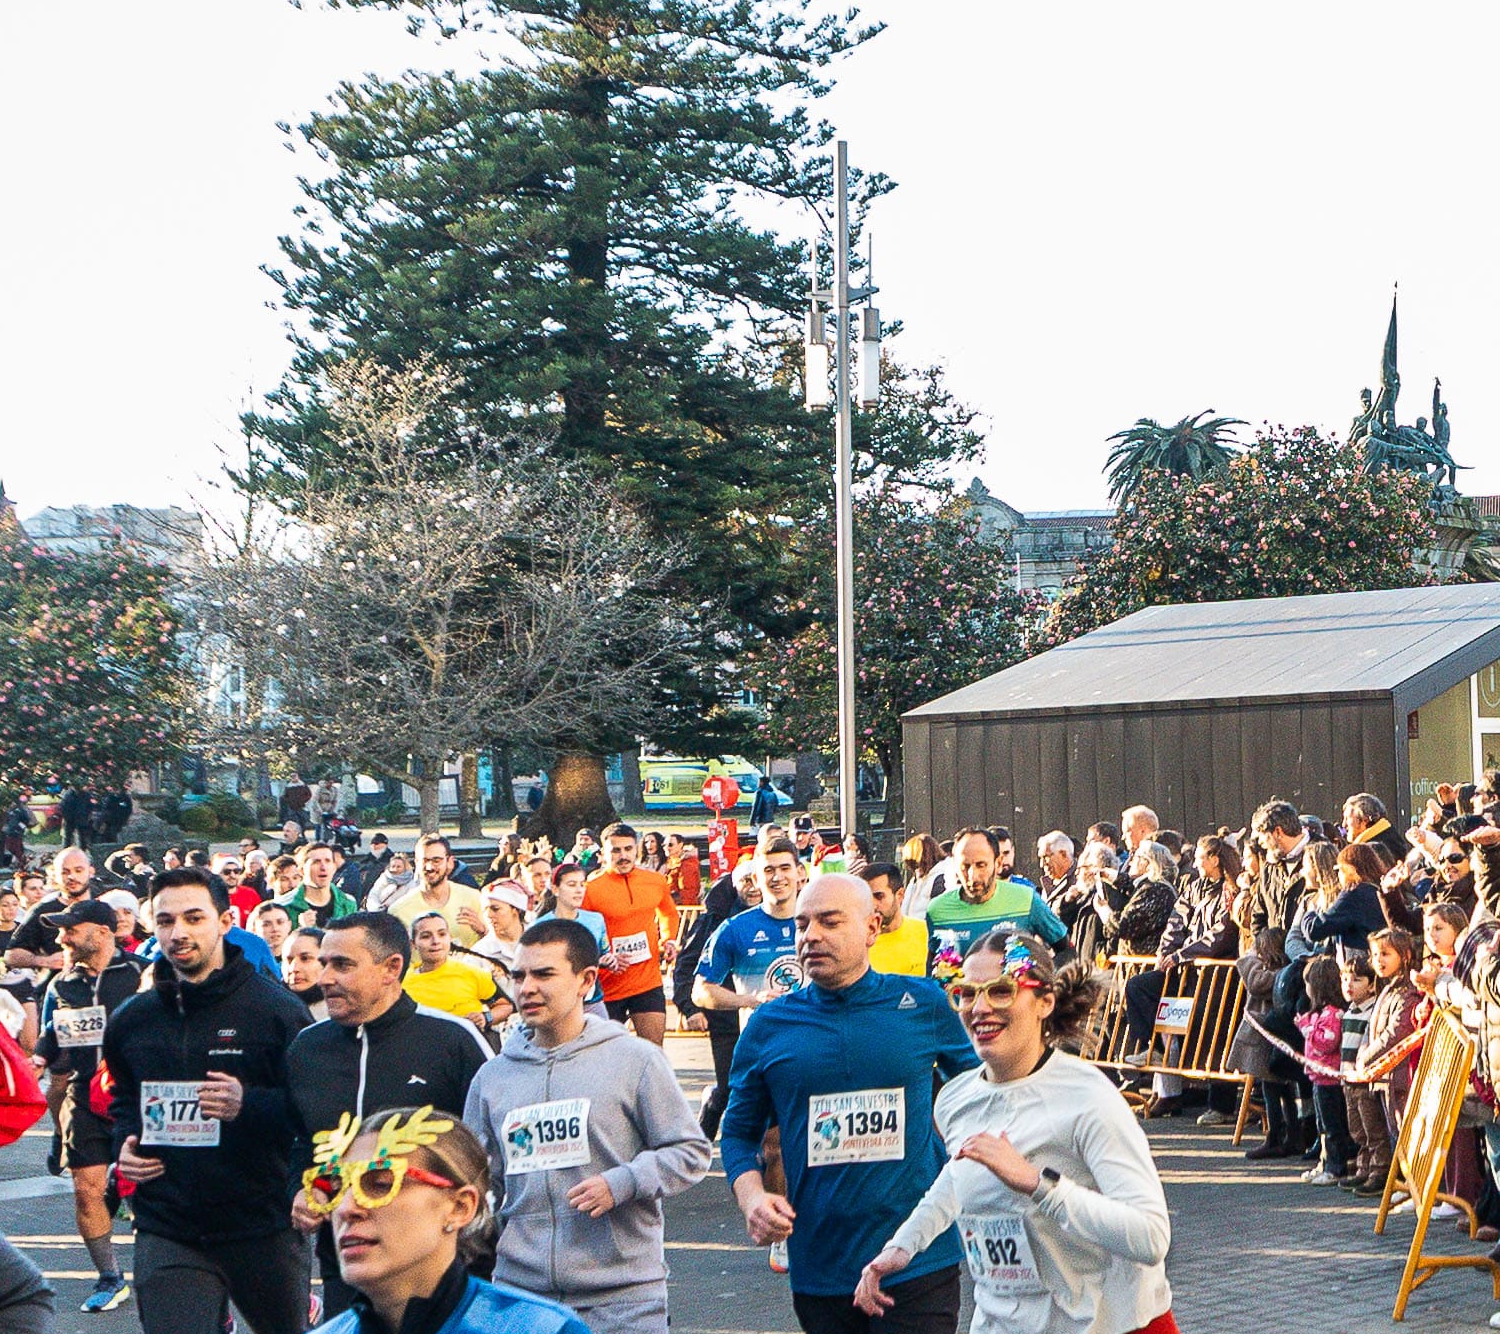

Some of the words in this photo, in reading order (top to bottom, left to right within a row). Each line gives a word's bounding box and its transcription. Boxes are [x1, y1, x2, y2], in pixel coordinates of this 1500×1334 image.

[833, 1095, 853, 1112] SAN
[854, 1093, 899, 1111] SILVESTRE
[535, 1116, 580, 1143] 1396
[845, 1110, 898, 1136] 1394
[985, 1238, 1022, 1265] 812
